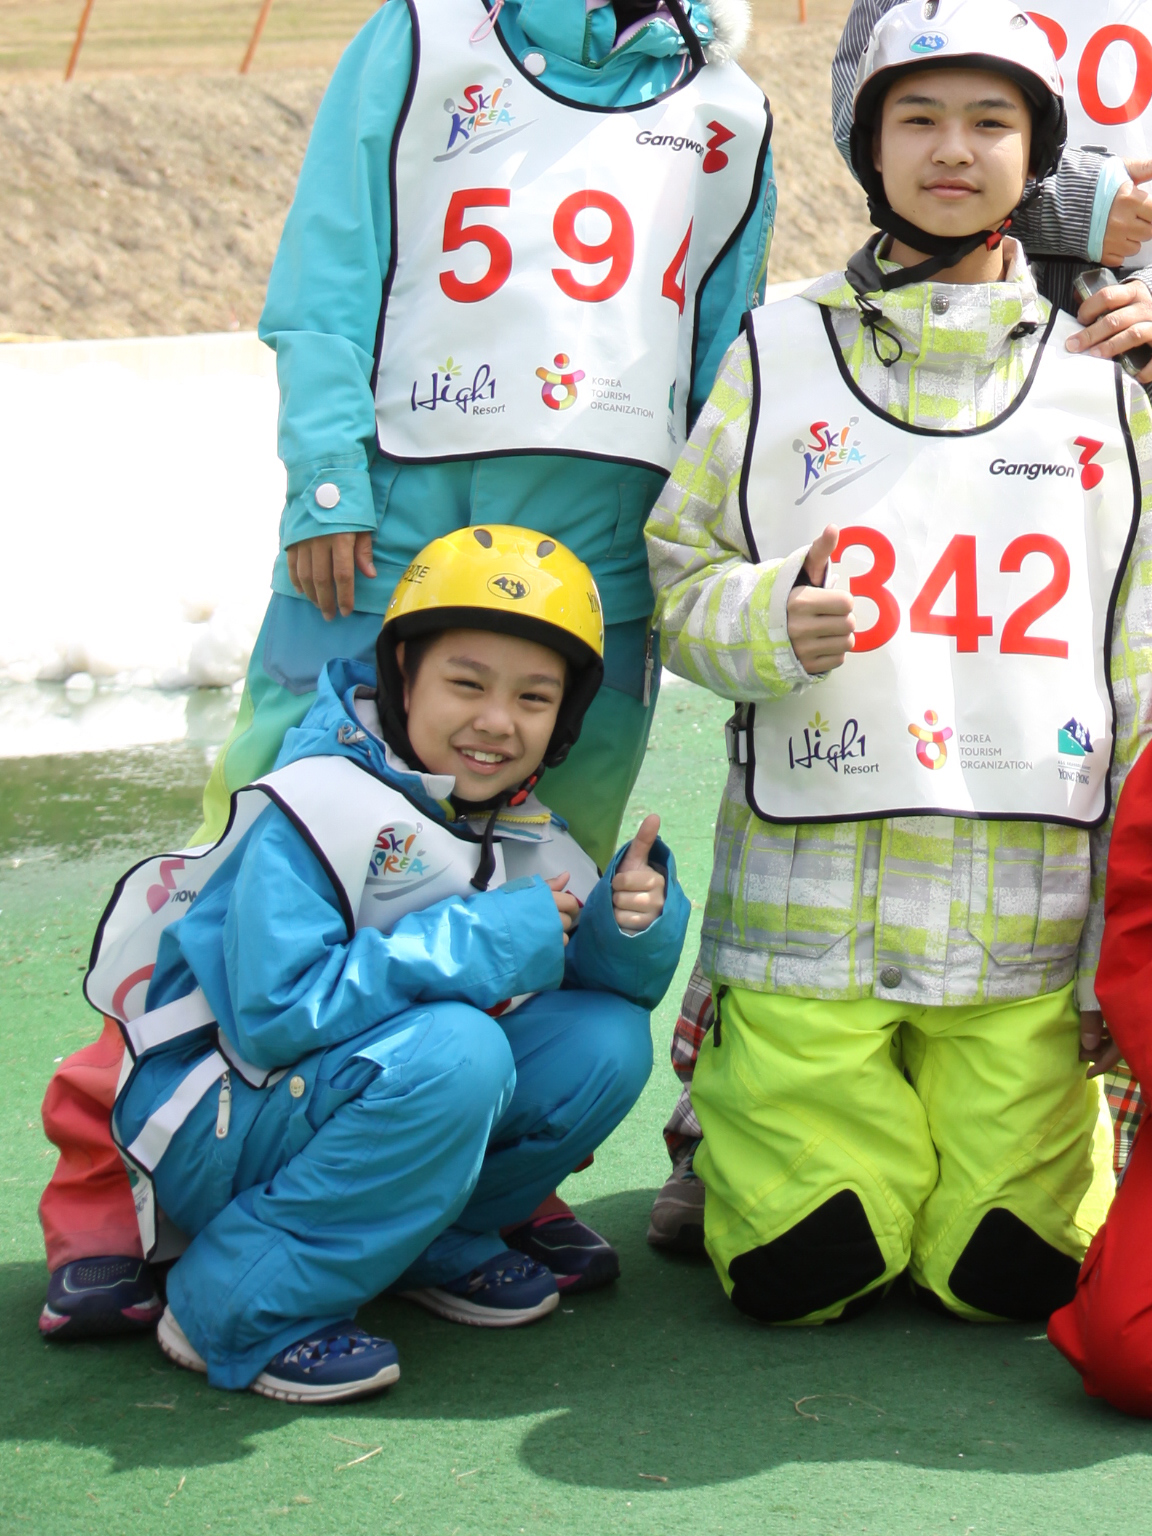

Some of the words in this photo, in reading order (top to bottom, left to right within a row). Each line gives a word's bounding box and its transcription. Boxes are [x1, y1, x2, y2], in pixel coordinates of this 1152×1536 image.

[446, 109, 516, 152] KOREA
[592, 377, 622, 388] KOREA
[591, 389, 631, 401] TOURISM
[473, 404, 506, 415] Resort
[590, 401, 654, 419] ORGANIZATION
[803, 447, 866, 493] KOREA
[989, 458, 1075, 480] Gangwon
[830, 526, 1071, 660] 342
[960, 734, 992, 743] KOREA
[960, 747, 1002, 756] TOURISM
[844, 763, 880, 775] Resort
[960, 760, 1033, 770] ORGANIZATION
